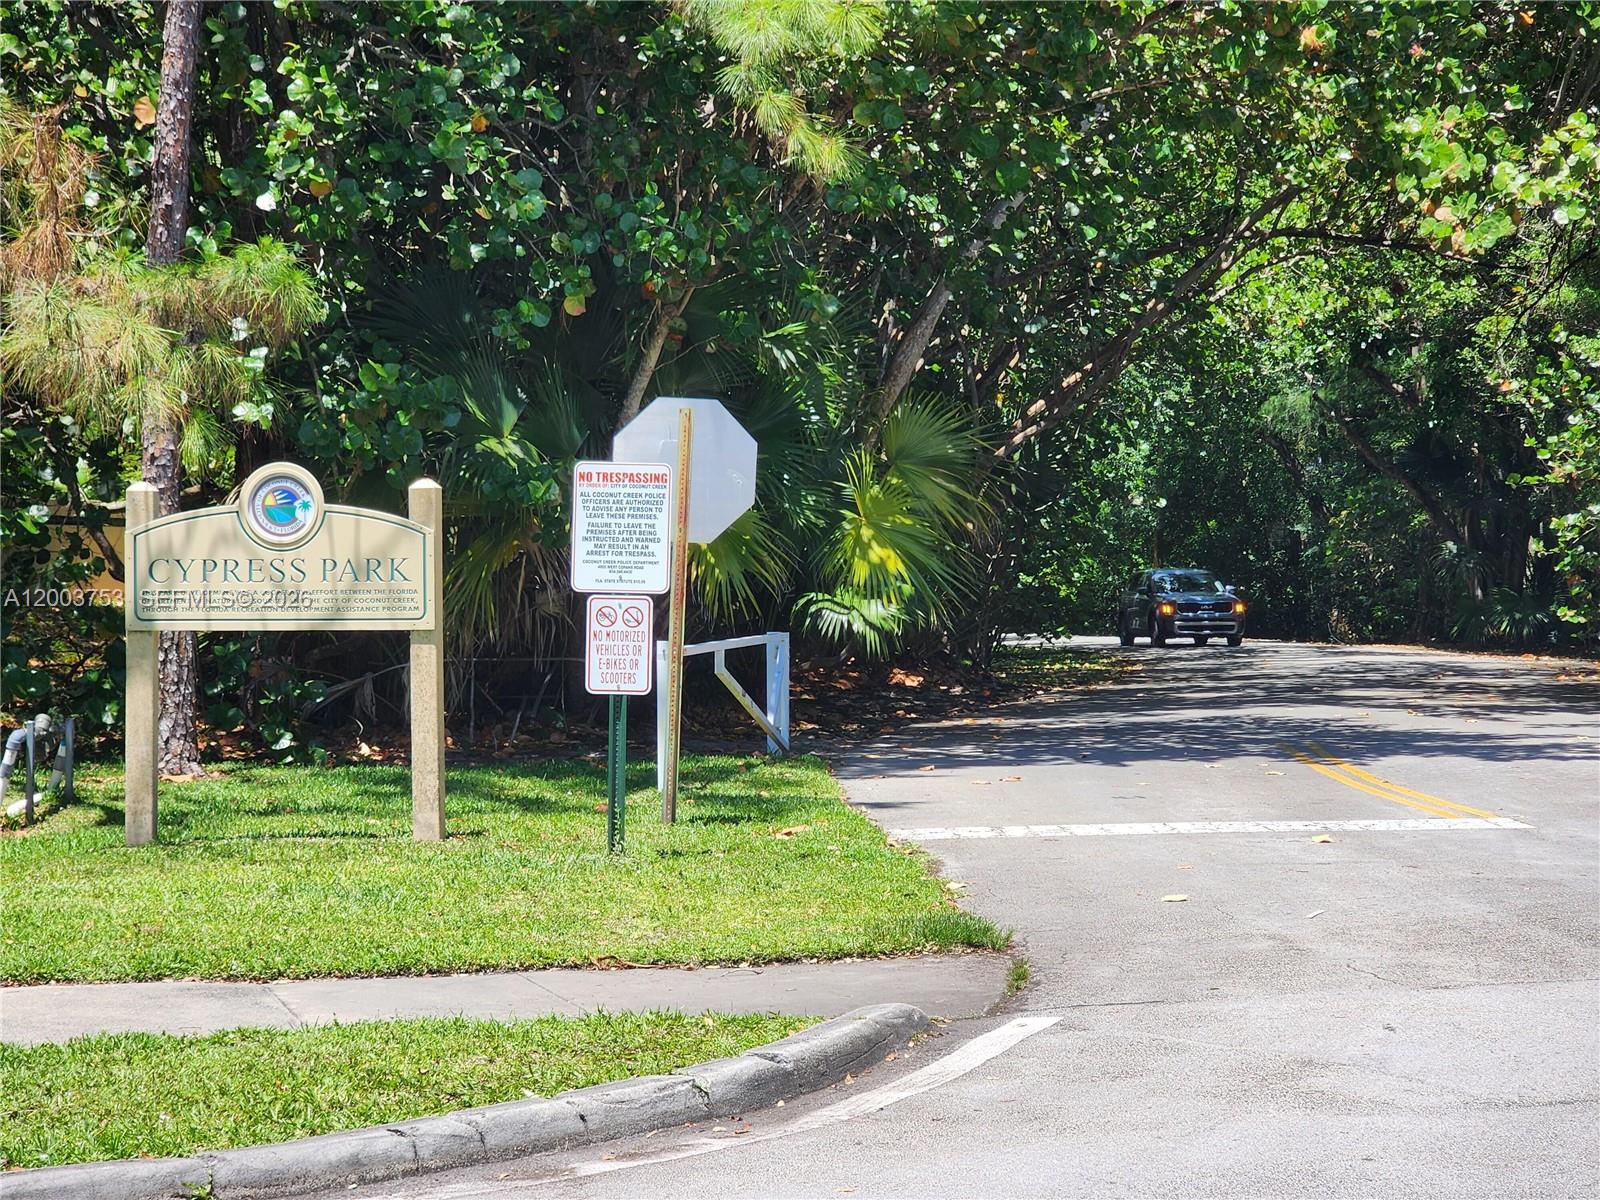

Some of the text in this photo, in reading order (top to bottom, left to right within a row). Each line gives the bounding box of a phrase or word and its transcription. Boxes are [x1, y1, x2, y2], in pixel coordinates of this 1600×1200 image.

[579, 471, 668, 484] NO TRESPASSING
[149, 557, 412, 583] CYPRESS PARK
[593, 630, 645, 643] NO MOTORIZED
[595, 644, 642, 657] VEHICLES OR
[599, 658, 639, 670] E-BIKES OR
[600, 672, 636, 684] SCOOTERS
